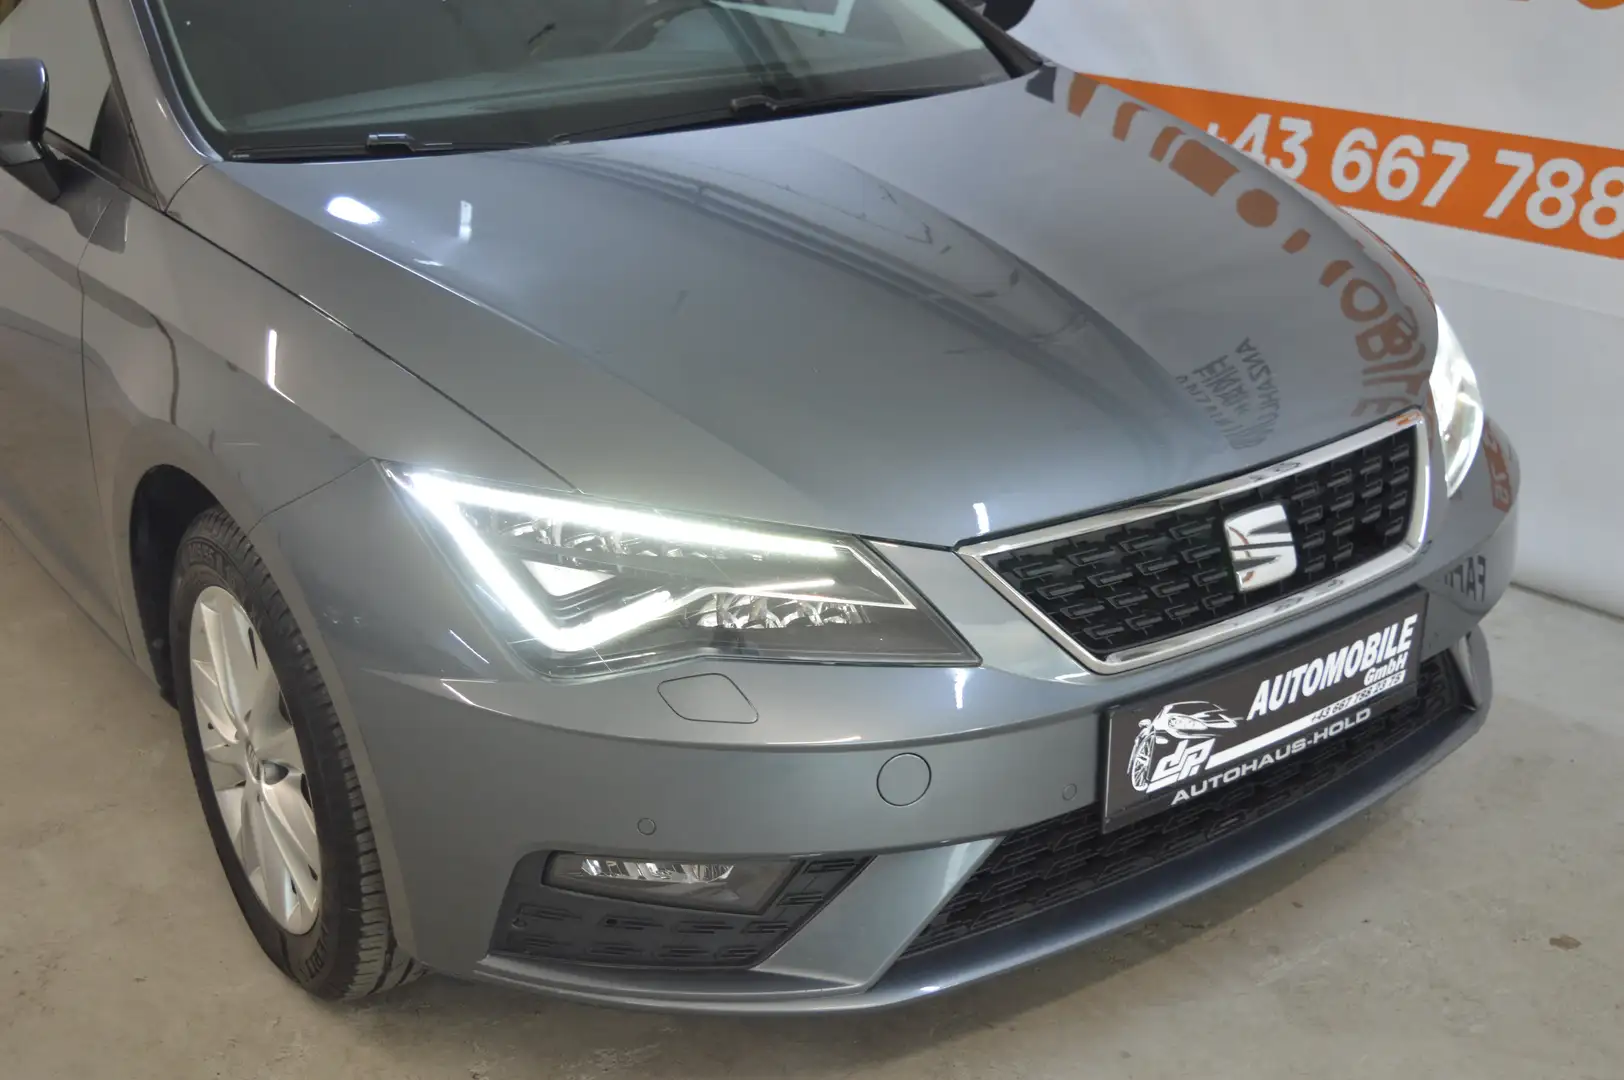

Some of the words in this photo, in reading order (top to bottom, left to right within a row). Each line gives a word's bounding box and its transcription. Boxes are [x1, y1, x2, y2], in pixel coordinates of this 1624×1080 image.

[1331, 127, 1470, 208] 667
[1483, 149, 1624, 240] 788
[1247, 614, 1418, 721] AUTOMOBILE
[1363, 651, 1409, 687] GmbH
[1170, 707, 1372, 806] AUTOHAUS-HOLD
